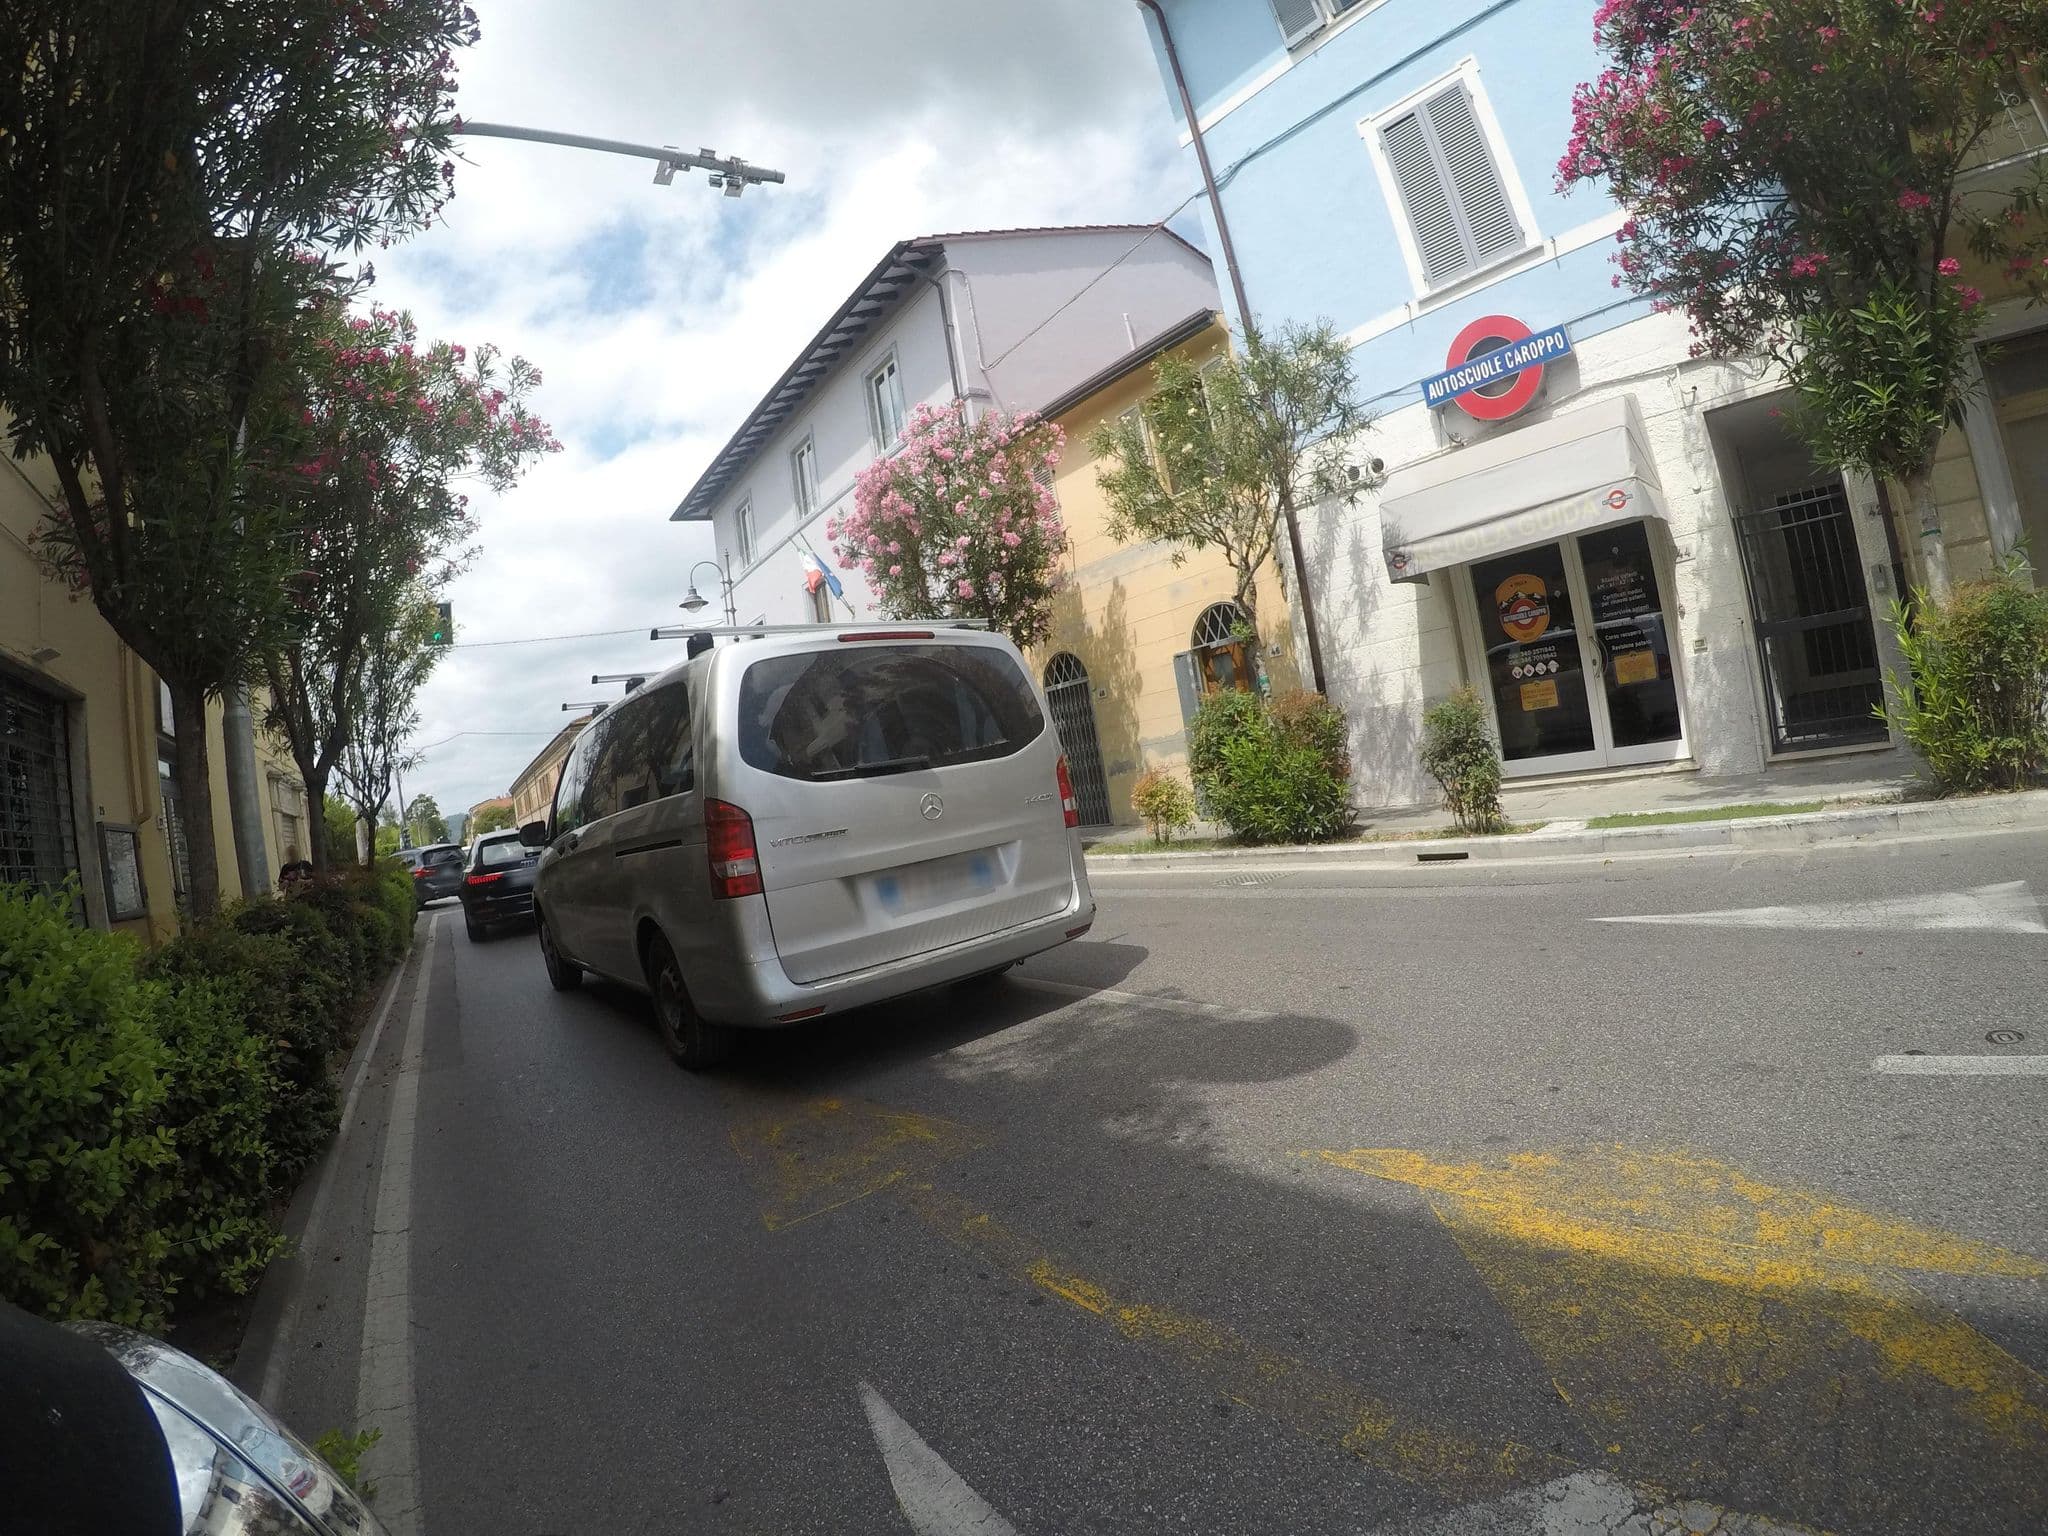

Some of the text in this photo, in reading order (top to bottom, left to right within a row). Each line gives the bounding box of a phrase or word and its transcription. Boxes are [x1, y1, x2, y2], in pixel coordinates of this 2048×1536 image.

[1428, 332, 1564, 400] AUTOSCUOLE CAROPPO
[1517, 496, 1600, 536] GUIDA
